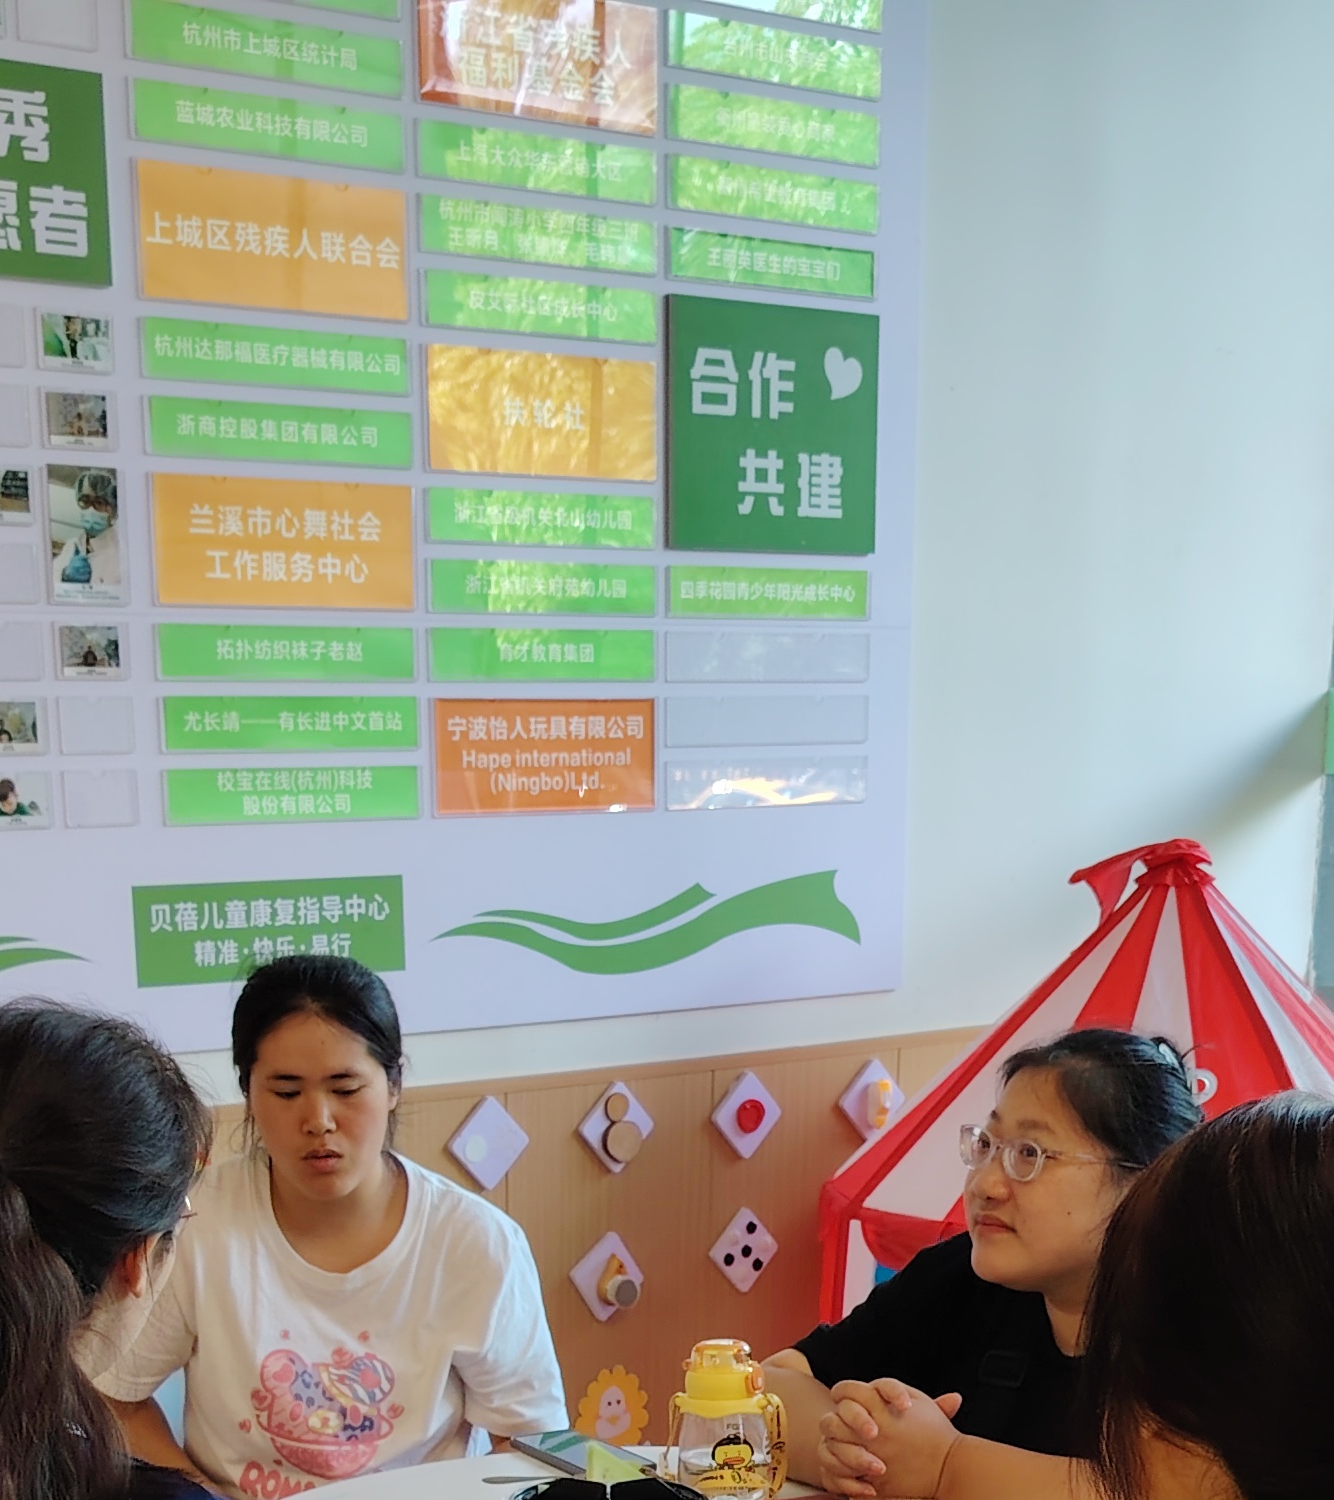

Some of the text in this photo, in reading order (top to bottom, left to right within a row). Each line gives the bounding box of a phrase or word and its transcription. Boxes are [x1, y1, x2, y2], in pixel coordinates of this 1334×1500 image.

[182, 21, 358, 71] 杭州市上城区统计局
[458, 46, 617, 107] 福利基金会
[175, 99, 369, 148] 蓝城农业科技有限公司
[146, 211, 400, 269] 上城区残疾人联合会
[154, 334, 401, 375] 杭州达那福医疗器械有限公司
[690, 347, 796, 420] 合作
[176, 413, 378, 448] 浙商控股集团有限公司
[503, 396, 586, 431] 扶轮社
[737, 448, 843, 519] 共建
[188, 503, 382, 542] 兰溪市心舞社会
[205, 550, 369, 584] 工作服务中心
[680, 579, 855, 603] 四季花园青少年阳光成长中心
[216, 638, 364, 662] 拓扑纺织袜子老赵
[499, 642, 595, 663] 育才教育集团
[447, 715, 645, 741] 宁波怡人玩具有限公司
[462, 747, 632, 771] Hape international
[217, 770, 373, 792] 校宝在线(杭州)科技
[490, 771, 606, 796] (Ningbo)Ltd.
[243, 794, 351, 816] 股份有限公司
[150, 893, 390, 933] 贝蓓儿童康复指导中心
